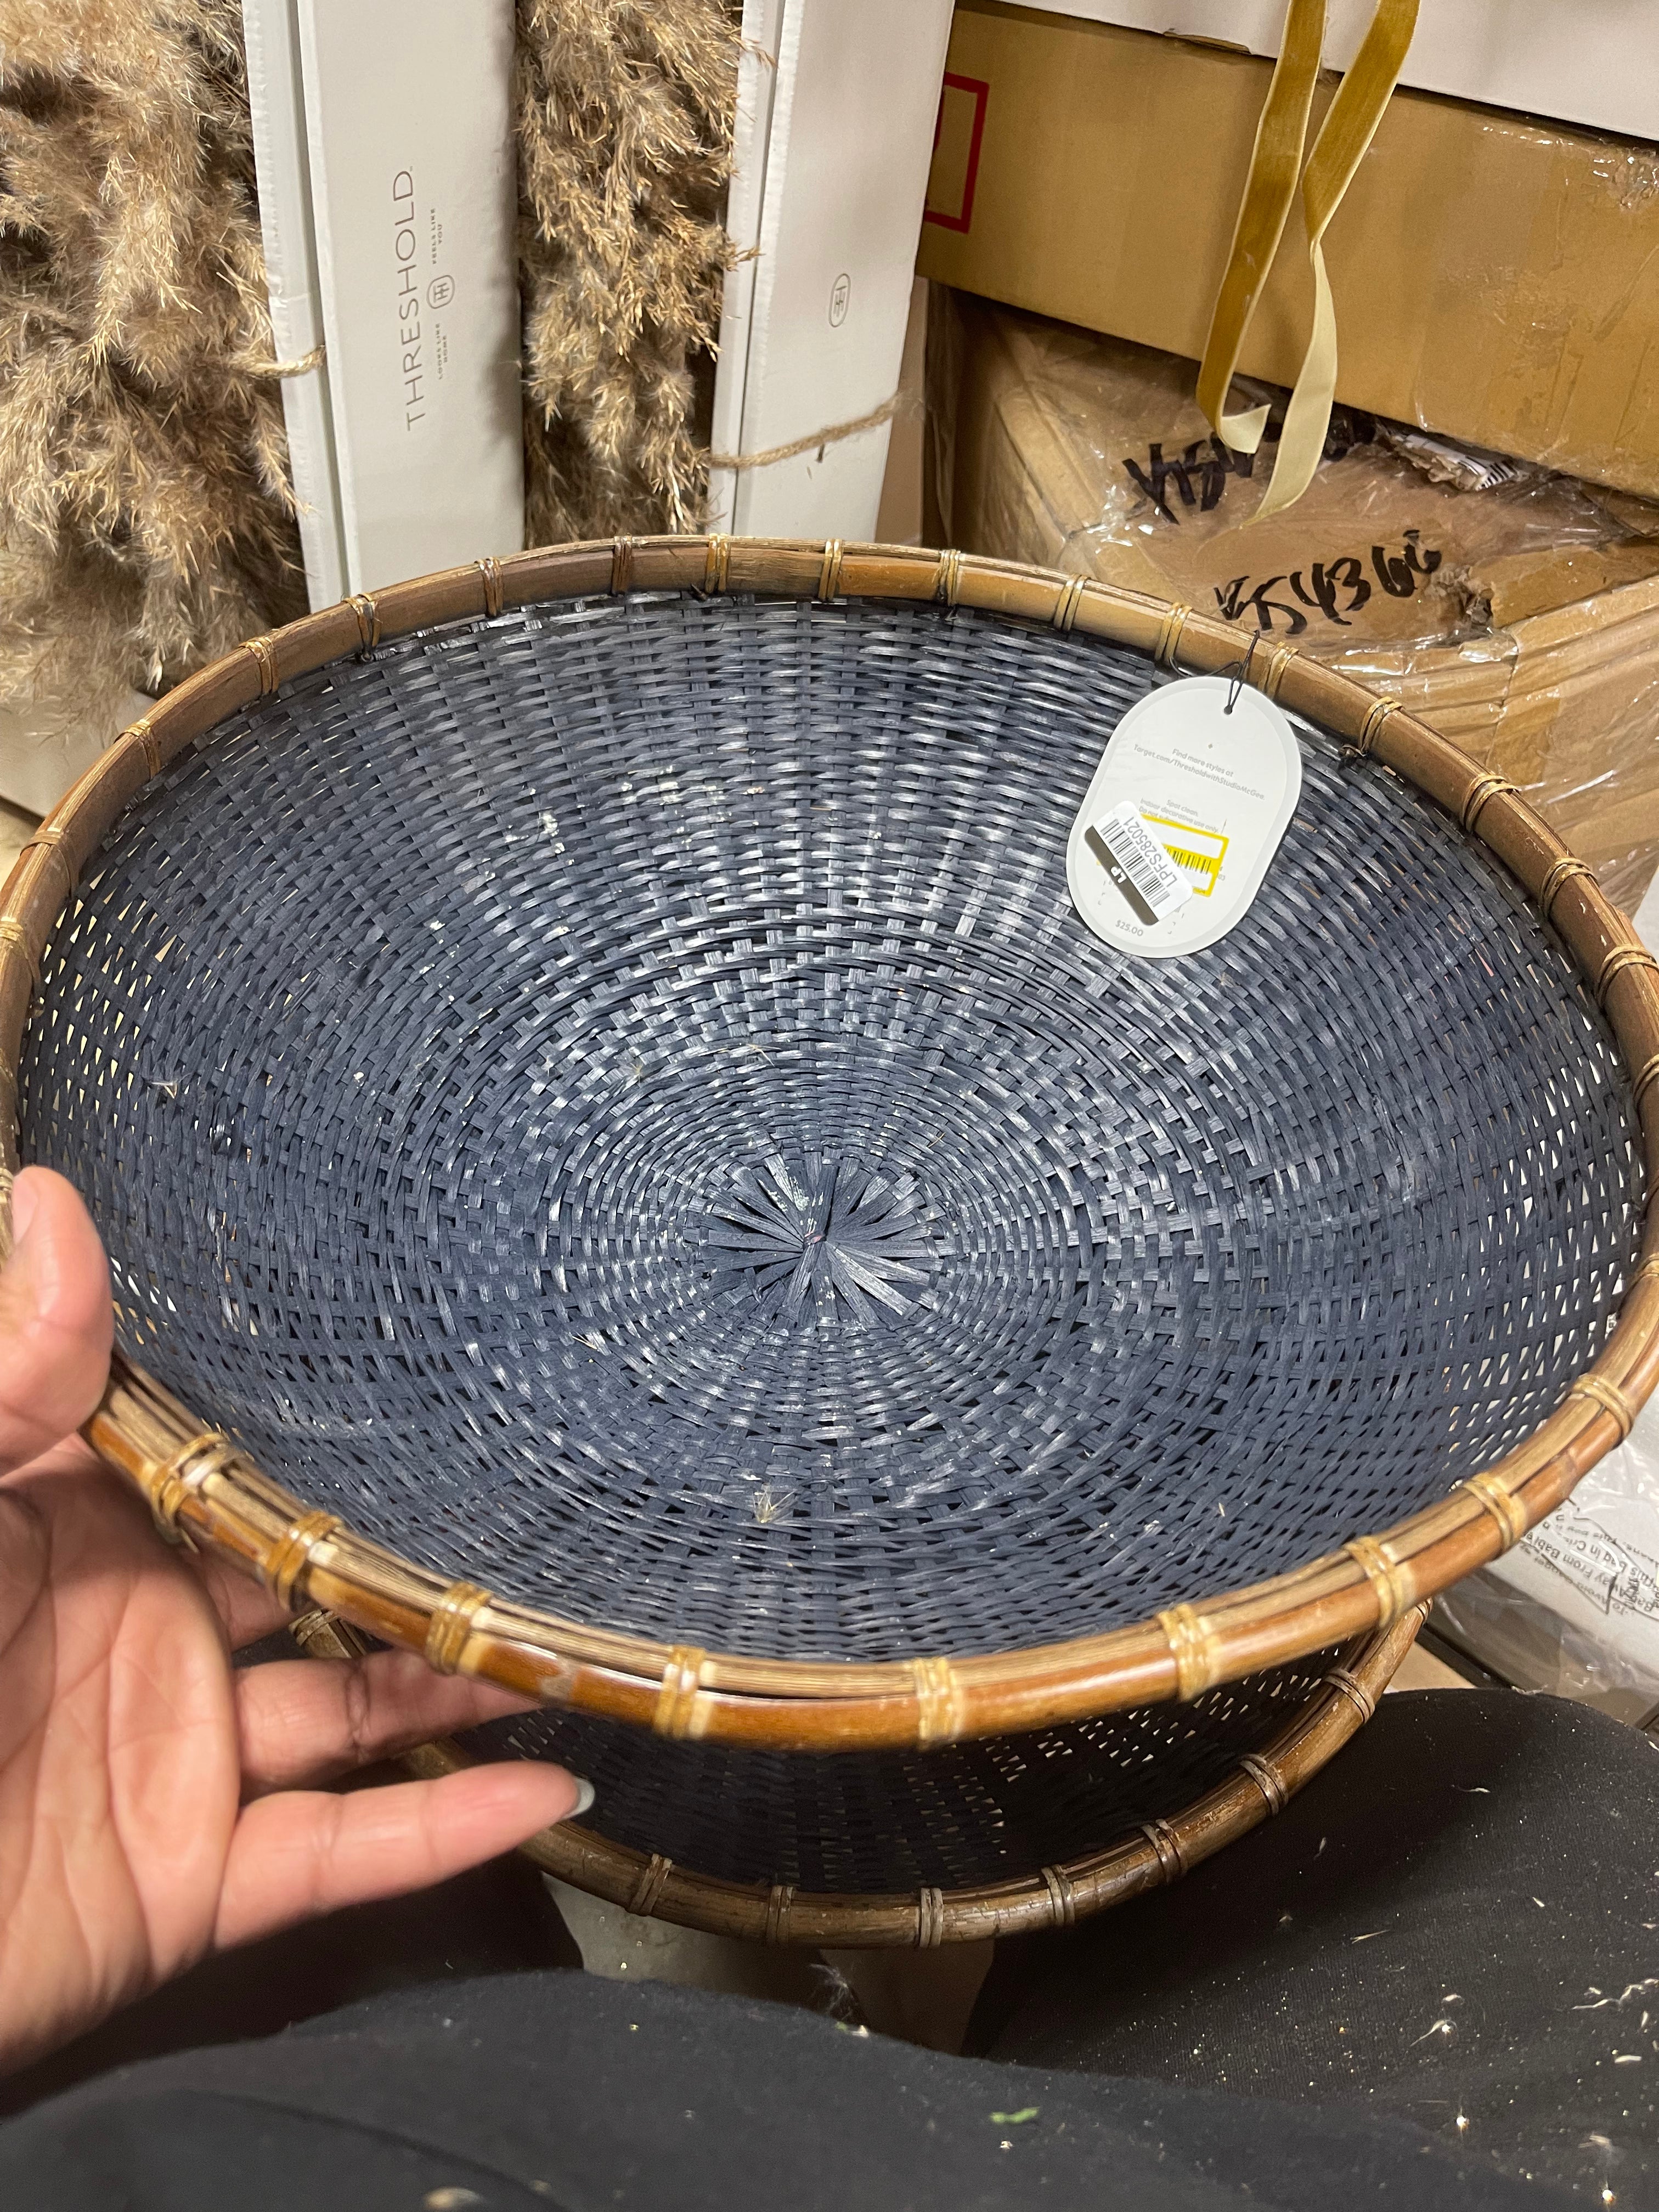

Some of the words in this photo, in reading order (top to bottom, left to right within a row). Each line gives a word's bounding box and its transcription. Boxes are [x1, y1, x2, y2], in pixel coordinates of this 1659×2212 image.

[393, 171, 425, 431] THRESHOLD
[1172, 748, 1188, 759] Find
[1188, 756, 1205, 766] more
[1205, 763, 1224, 774] styles
[1140, 798, 1161, 810] Indoor
[1161, 806, 1193, 823] decorative
[1193, 819, 1205, 828] use
[1166, 799, 1181, 811] Spot
[1123, 816, 1178, 888] LPFS285021
[1110, 866, 1127, 884] LP
[1115, 919, 1144, 937] $25.00
[1562, 1553, 1594, 1578] From
